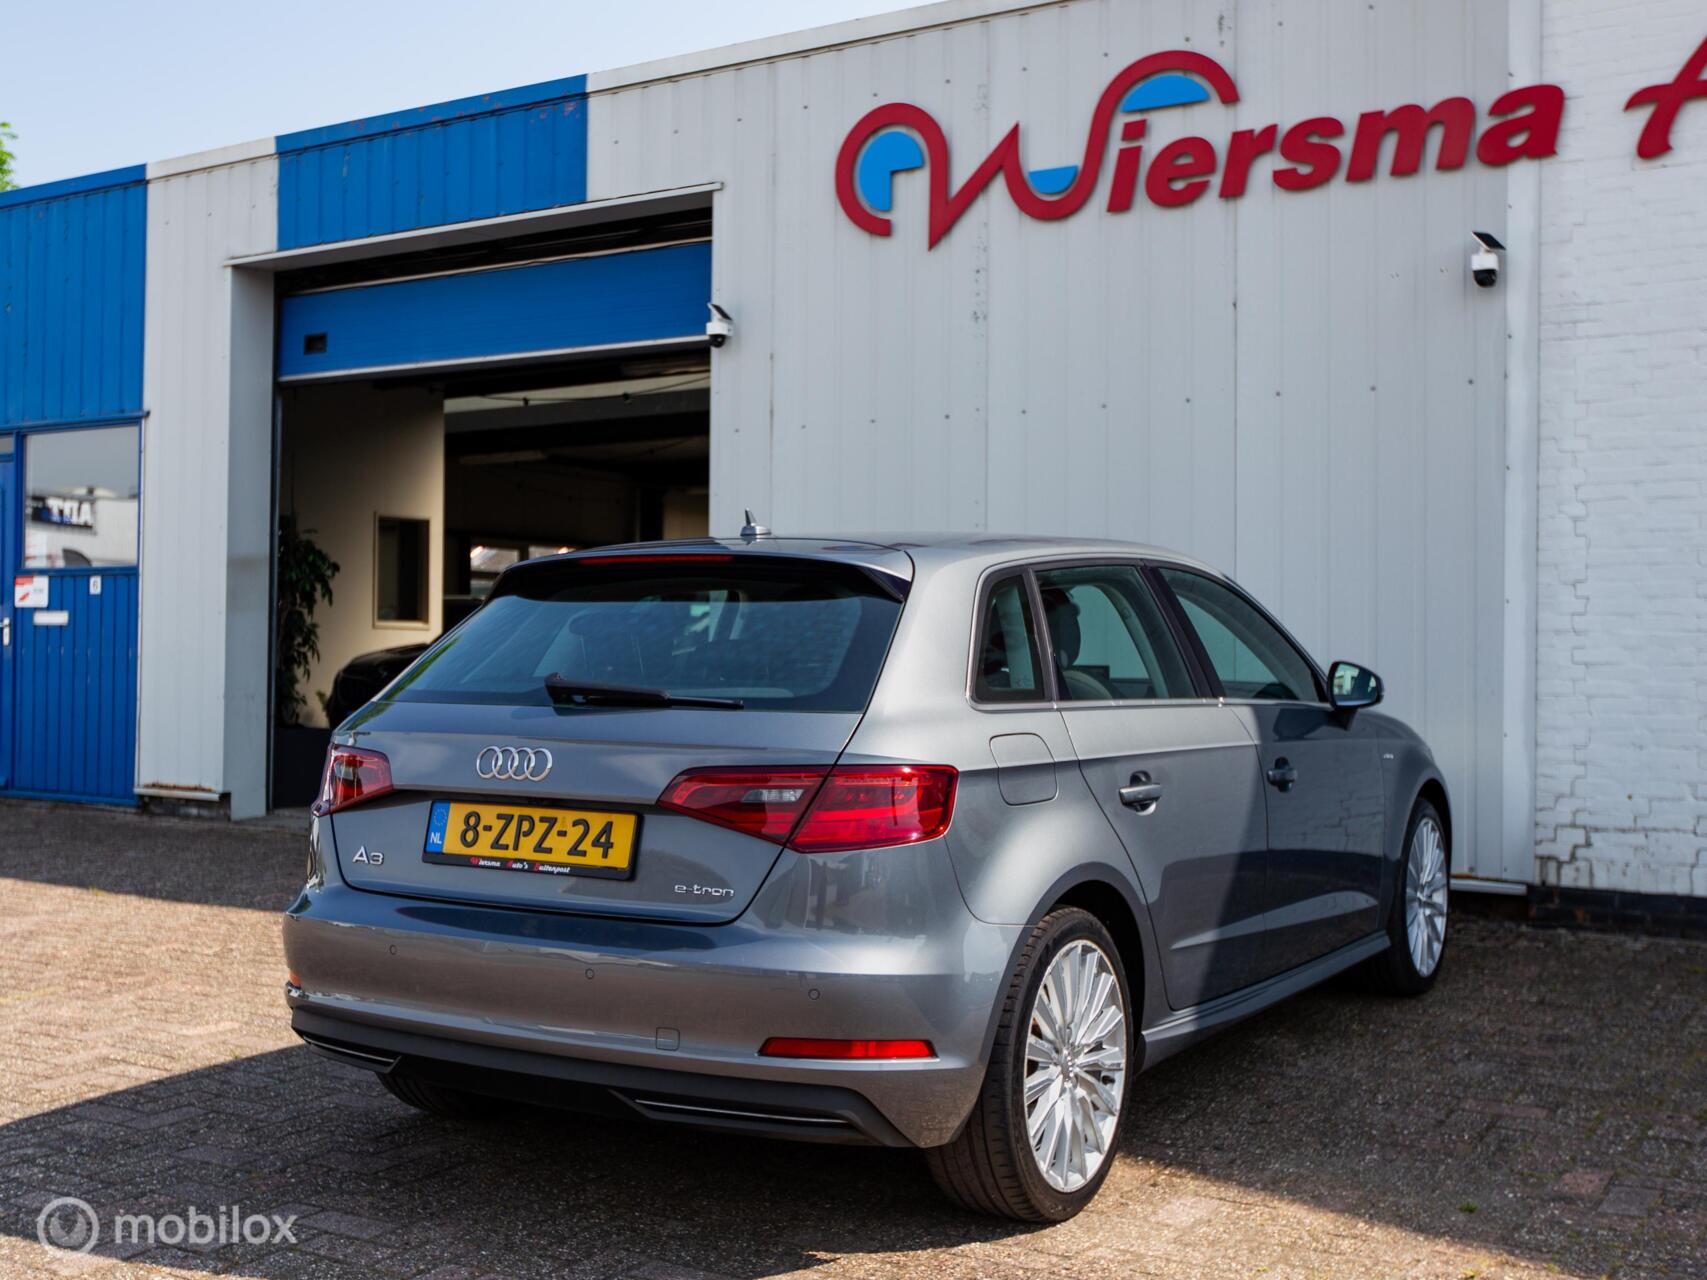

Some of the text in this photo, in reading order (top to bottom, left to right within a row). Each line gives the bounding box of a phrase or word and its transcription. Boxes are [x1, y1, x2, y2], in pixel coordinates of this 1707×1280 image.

[835, 50, 1564, 251] Wiersma
[430, 832, 442, 844] NL
[460, 811, 614, 859] 8-ZPZ-24
[352, 846, 384, 865] A3
[674, 884, 735, 897] e-tron
